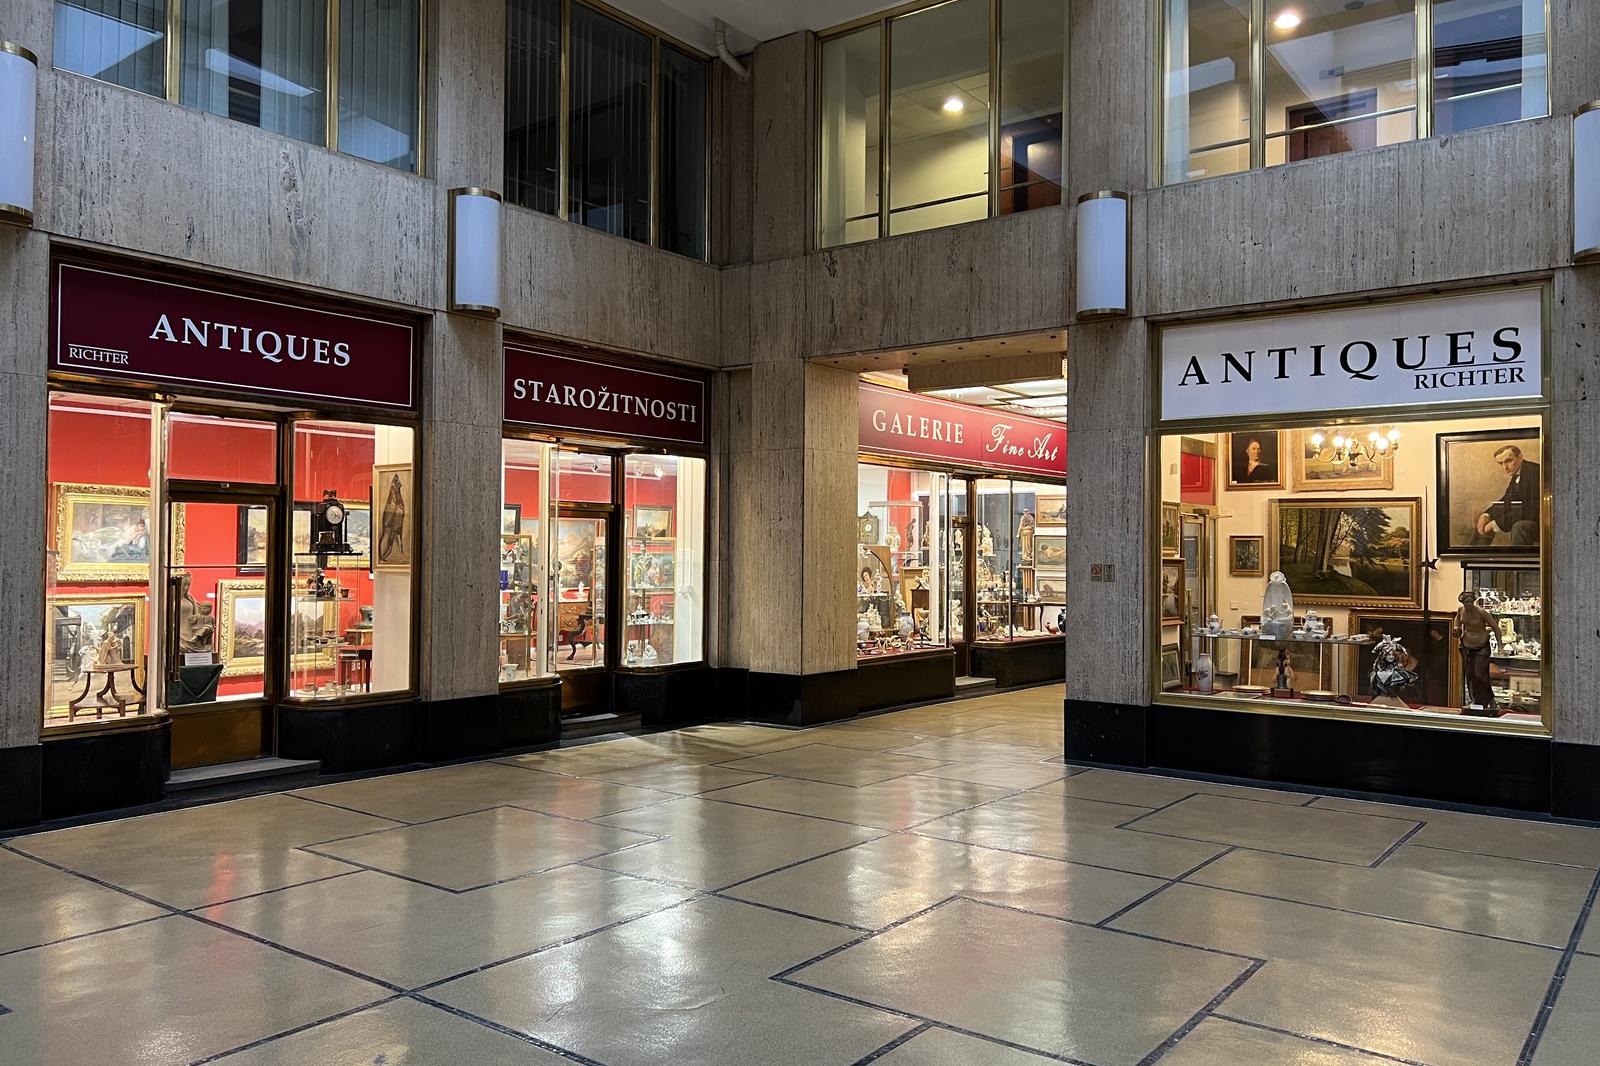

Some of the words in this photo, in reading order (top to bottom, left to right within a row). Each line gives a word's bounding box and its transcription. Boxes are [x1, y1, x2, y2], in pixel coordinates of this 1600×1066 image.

[69, 347, 129, 365] RICHTER
[149, 314, 351, 367] ANTIQUES
[1178, 327, 1522, 387] ANTIQUES
[514, 378, 697, 424] STAROŽITNOSTI
[1413, 367, 1525, 389] RICHTER
[872, 409, 964, 445] GALERIE
[986, 423, 1025, 457] Fine
[1027, 433, 1060, 462] Art
